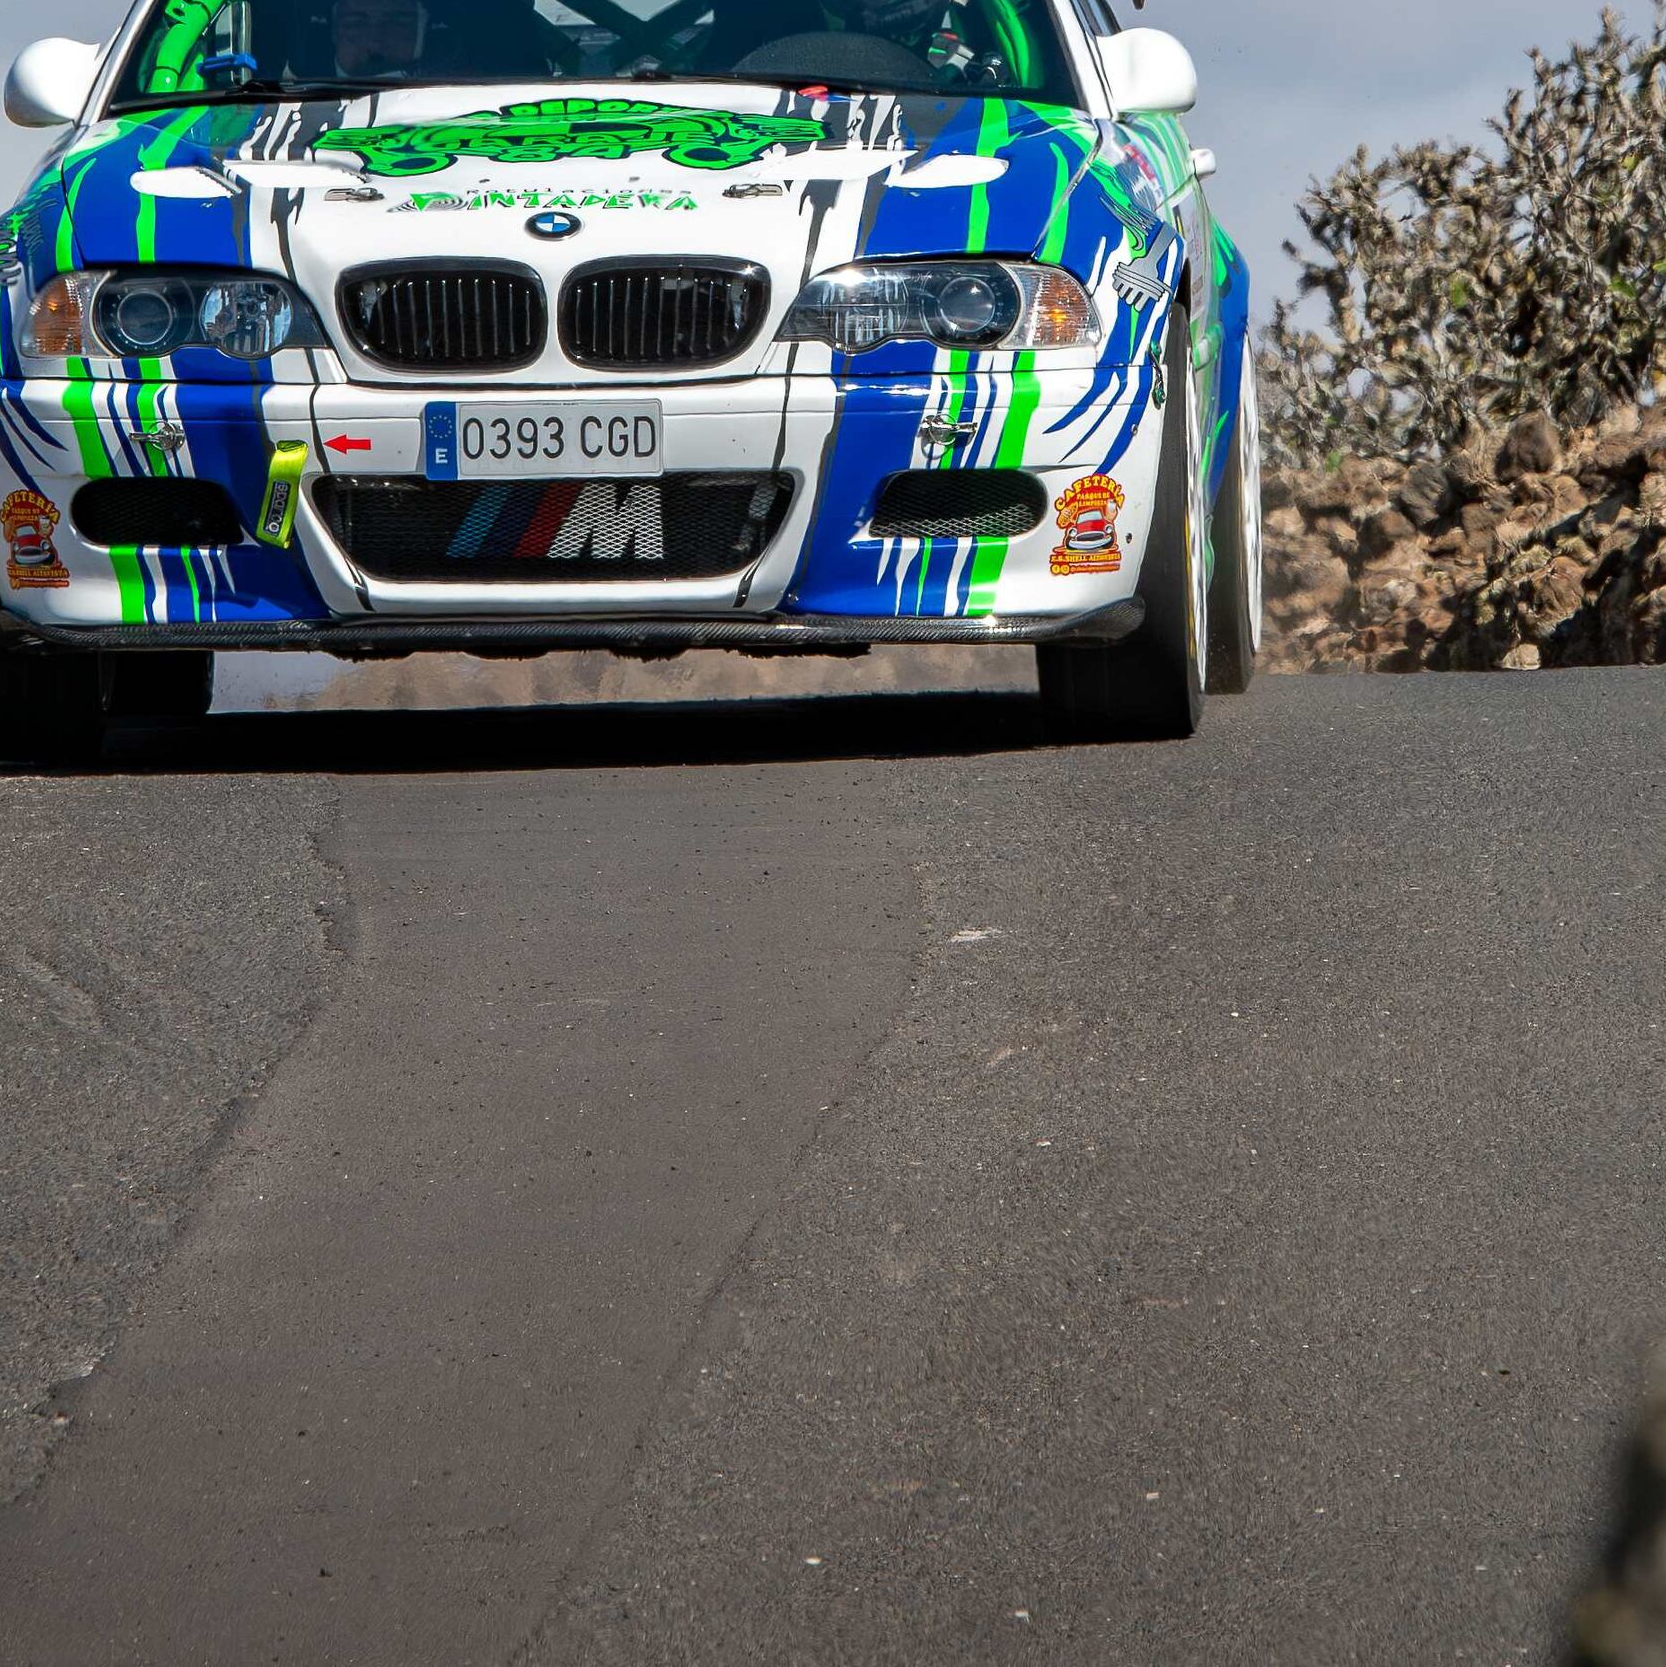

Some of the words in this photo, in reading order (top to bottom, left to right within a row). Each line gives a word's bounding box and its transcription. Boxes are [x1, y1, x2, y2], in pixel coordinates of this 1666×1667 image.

[463, 417, 565, 460] 0393
[580, 415, 656, 459] CGD
[435, 447, 448, 464] E
